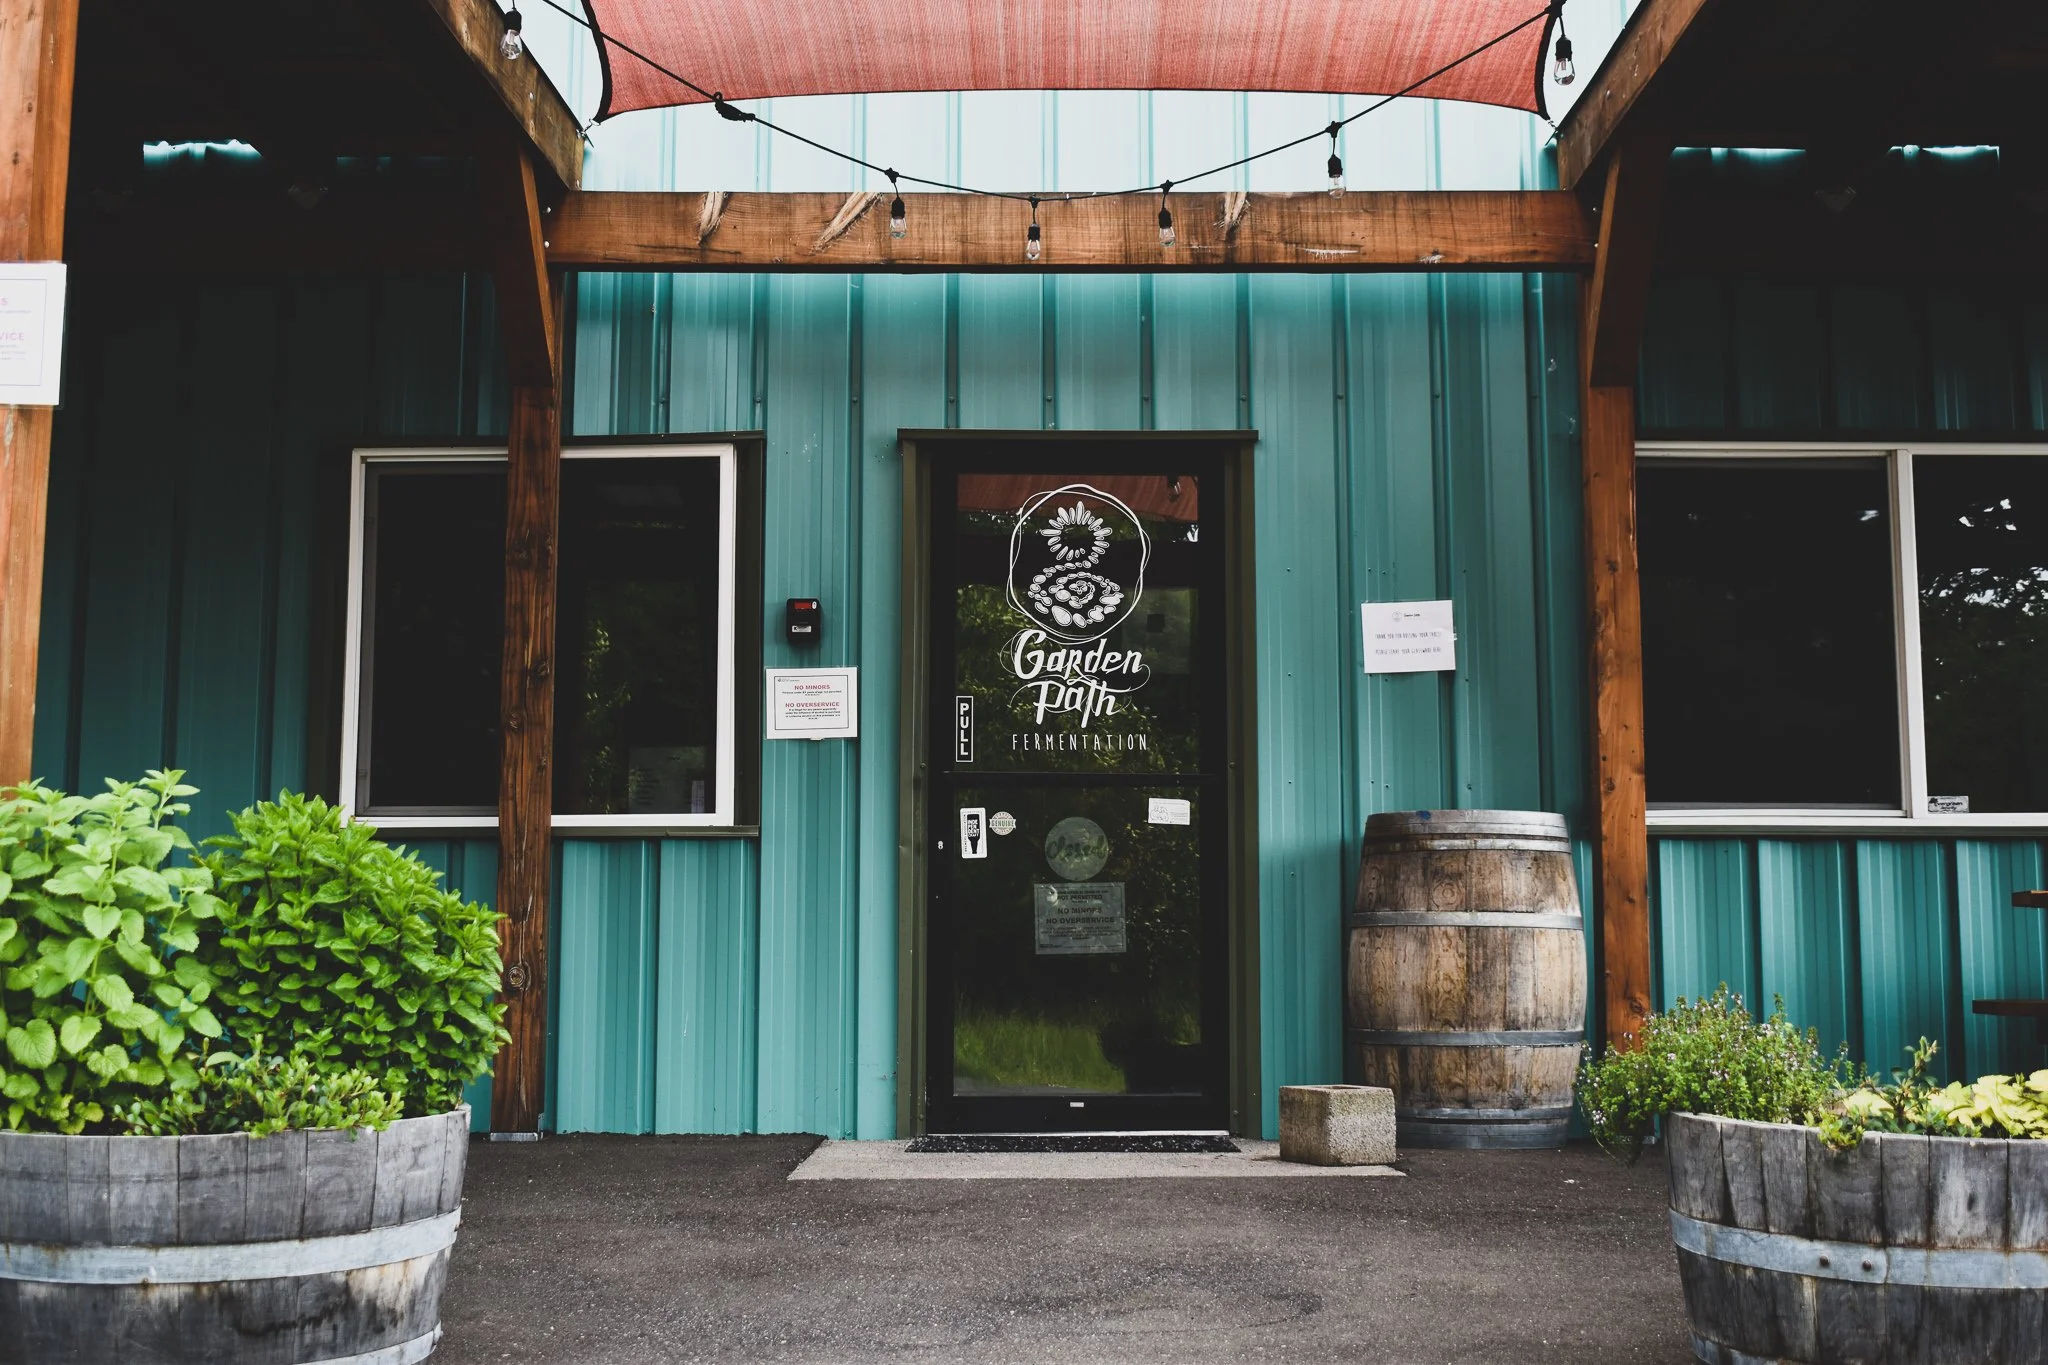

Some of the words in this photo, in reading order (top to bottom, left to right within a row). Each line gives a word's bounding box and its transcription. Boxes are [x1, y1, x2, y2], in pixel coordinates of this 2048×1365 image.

[1005, 629, 1146, 679] Garden
[1020, 677, 1126, 728] Path
[959, 702, 969, 756] PULL
[1012, 733, 1147, 751] FERMENTATION
